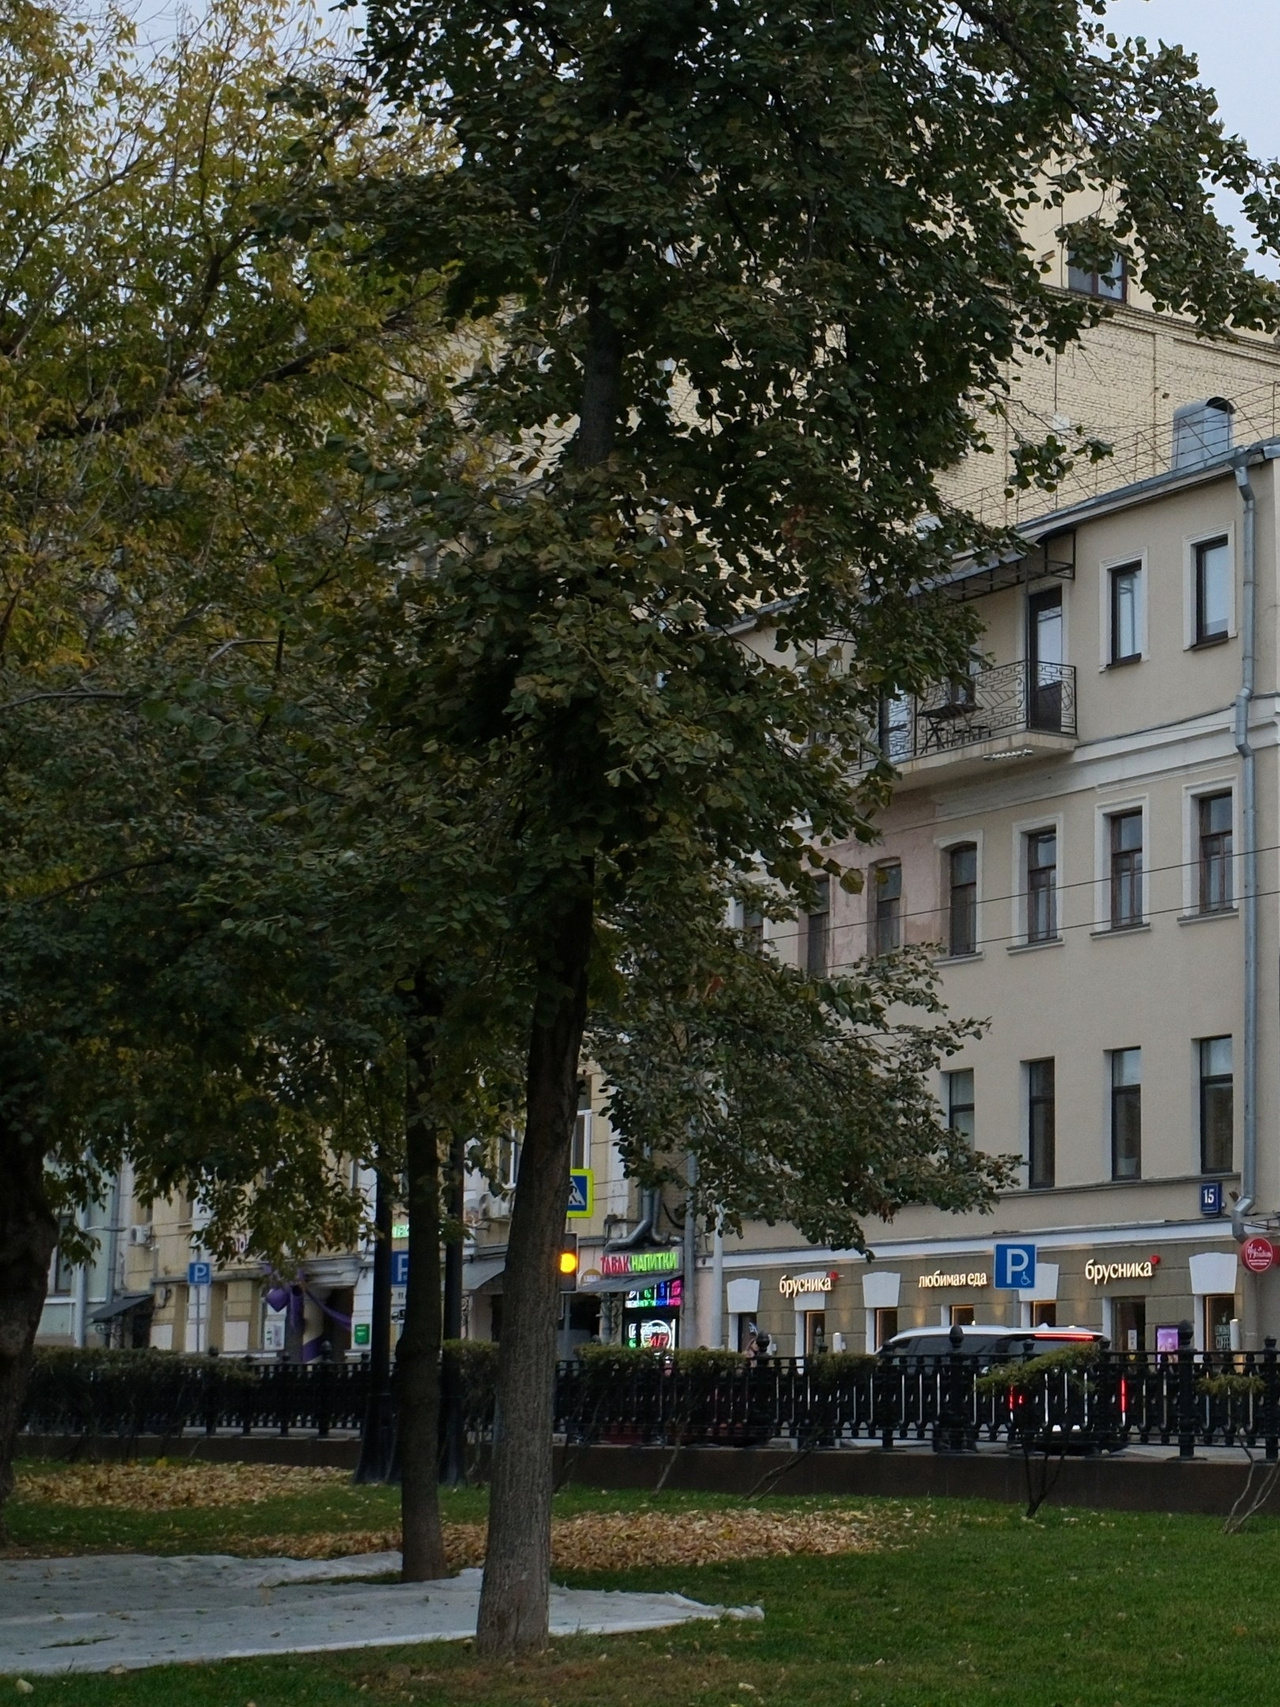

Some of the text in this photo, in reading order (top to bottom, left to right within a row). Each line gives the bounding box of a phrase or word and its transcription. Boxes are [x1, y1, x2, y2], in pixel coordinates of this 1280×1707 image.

[1203, 1188, 1215, 1204] 15
[631, 1253, 677, 1271] НАПИТКИ
[1006, 1248, 1029, 1284] P
[194, 1265, 207, 1281] P
[918, 1270, 987, 1288] любимая еда
[1084, 1259, 1153, 1285] брусника
[779, 1275, 832, 1298] брусника
